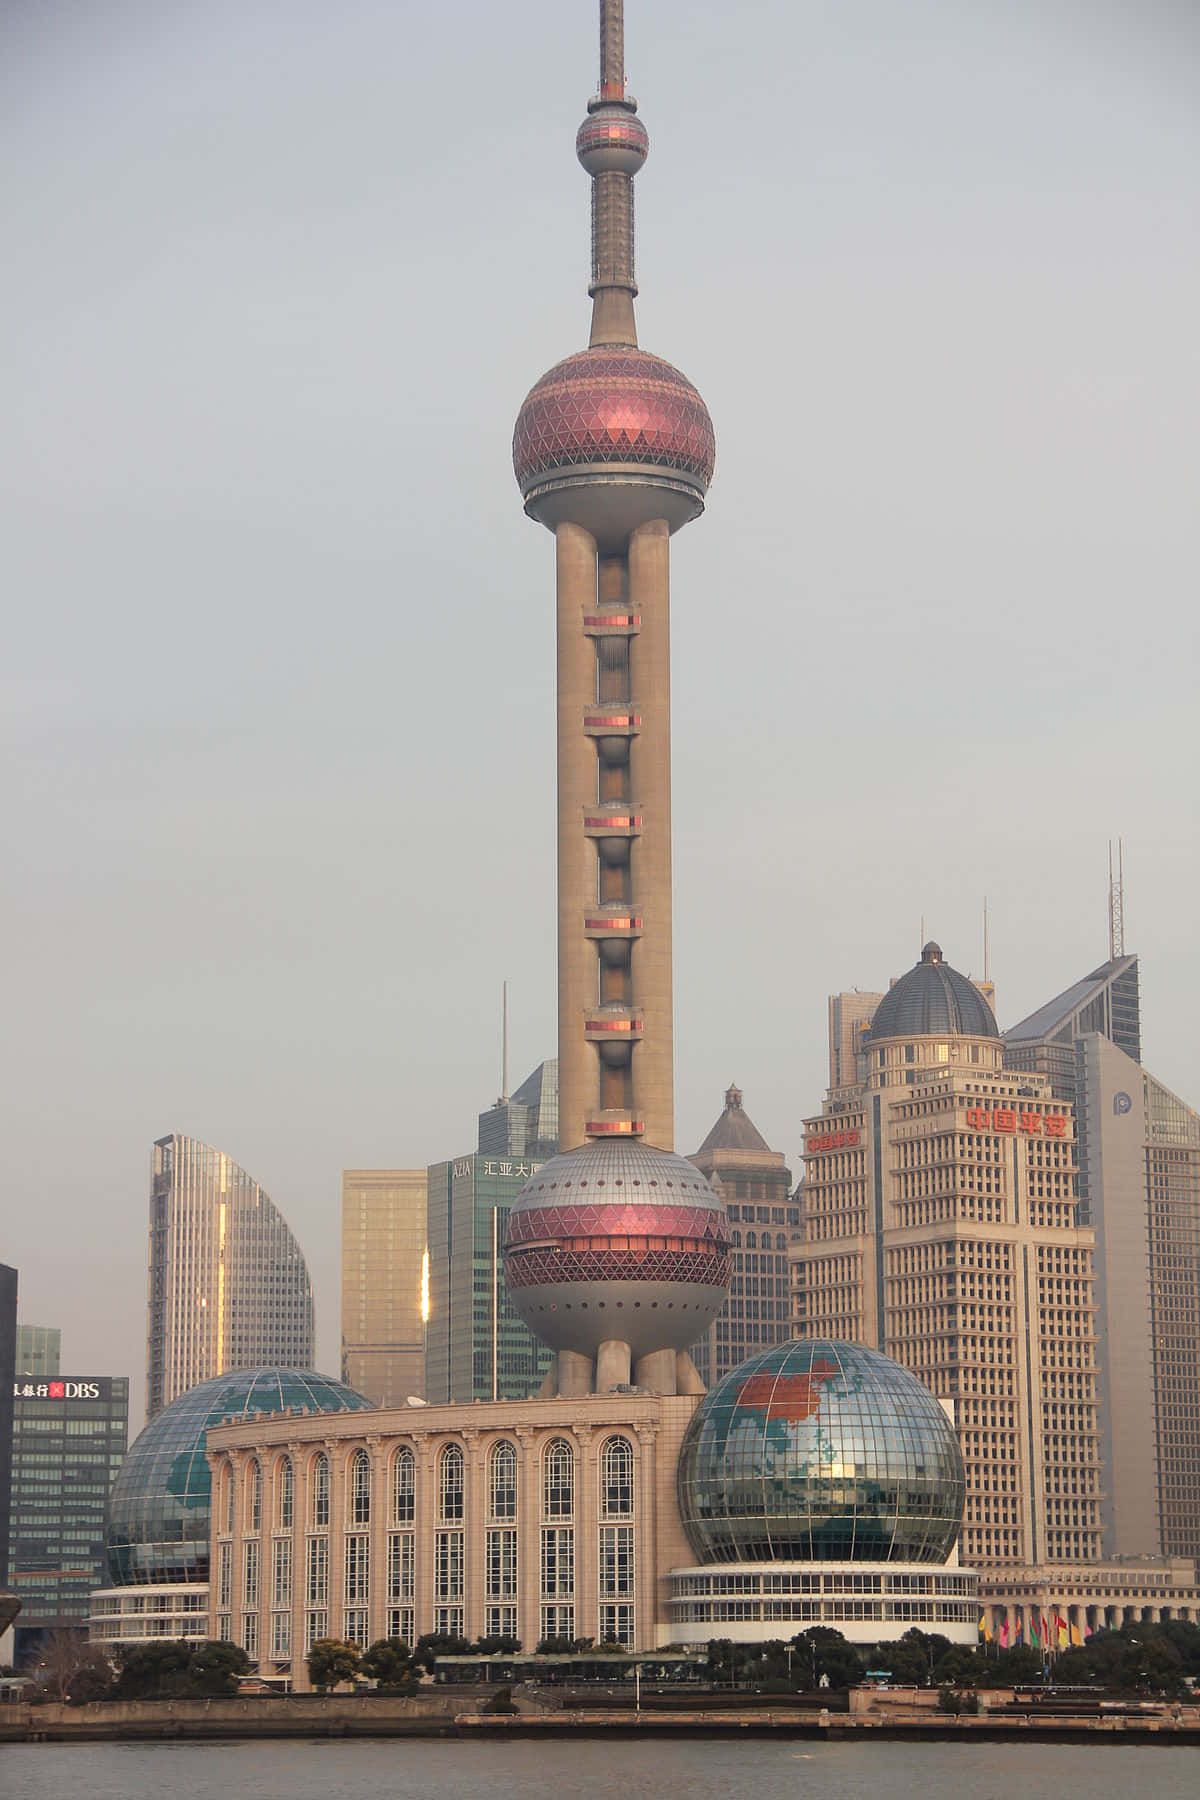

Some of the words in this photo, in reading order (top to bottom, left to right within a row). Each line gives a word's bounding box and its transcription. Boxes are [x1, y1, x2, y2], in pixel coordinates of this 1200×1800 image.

[967, 1107, 1066, 1136] 中国平安
[807, 1131, 858, 1152] 中国平安
[65, 1382, 99, 1398] DBS
